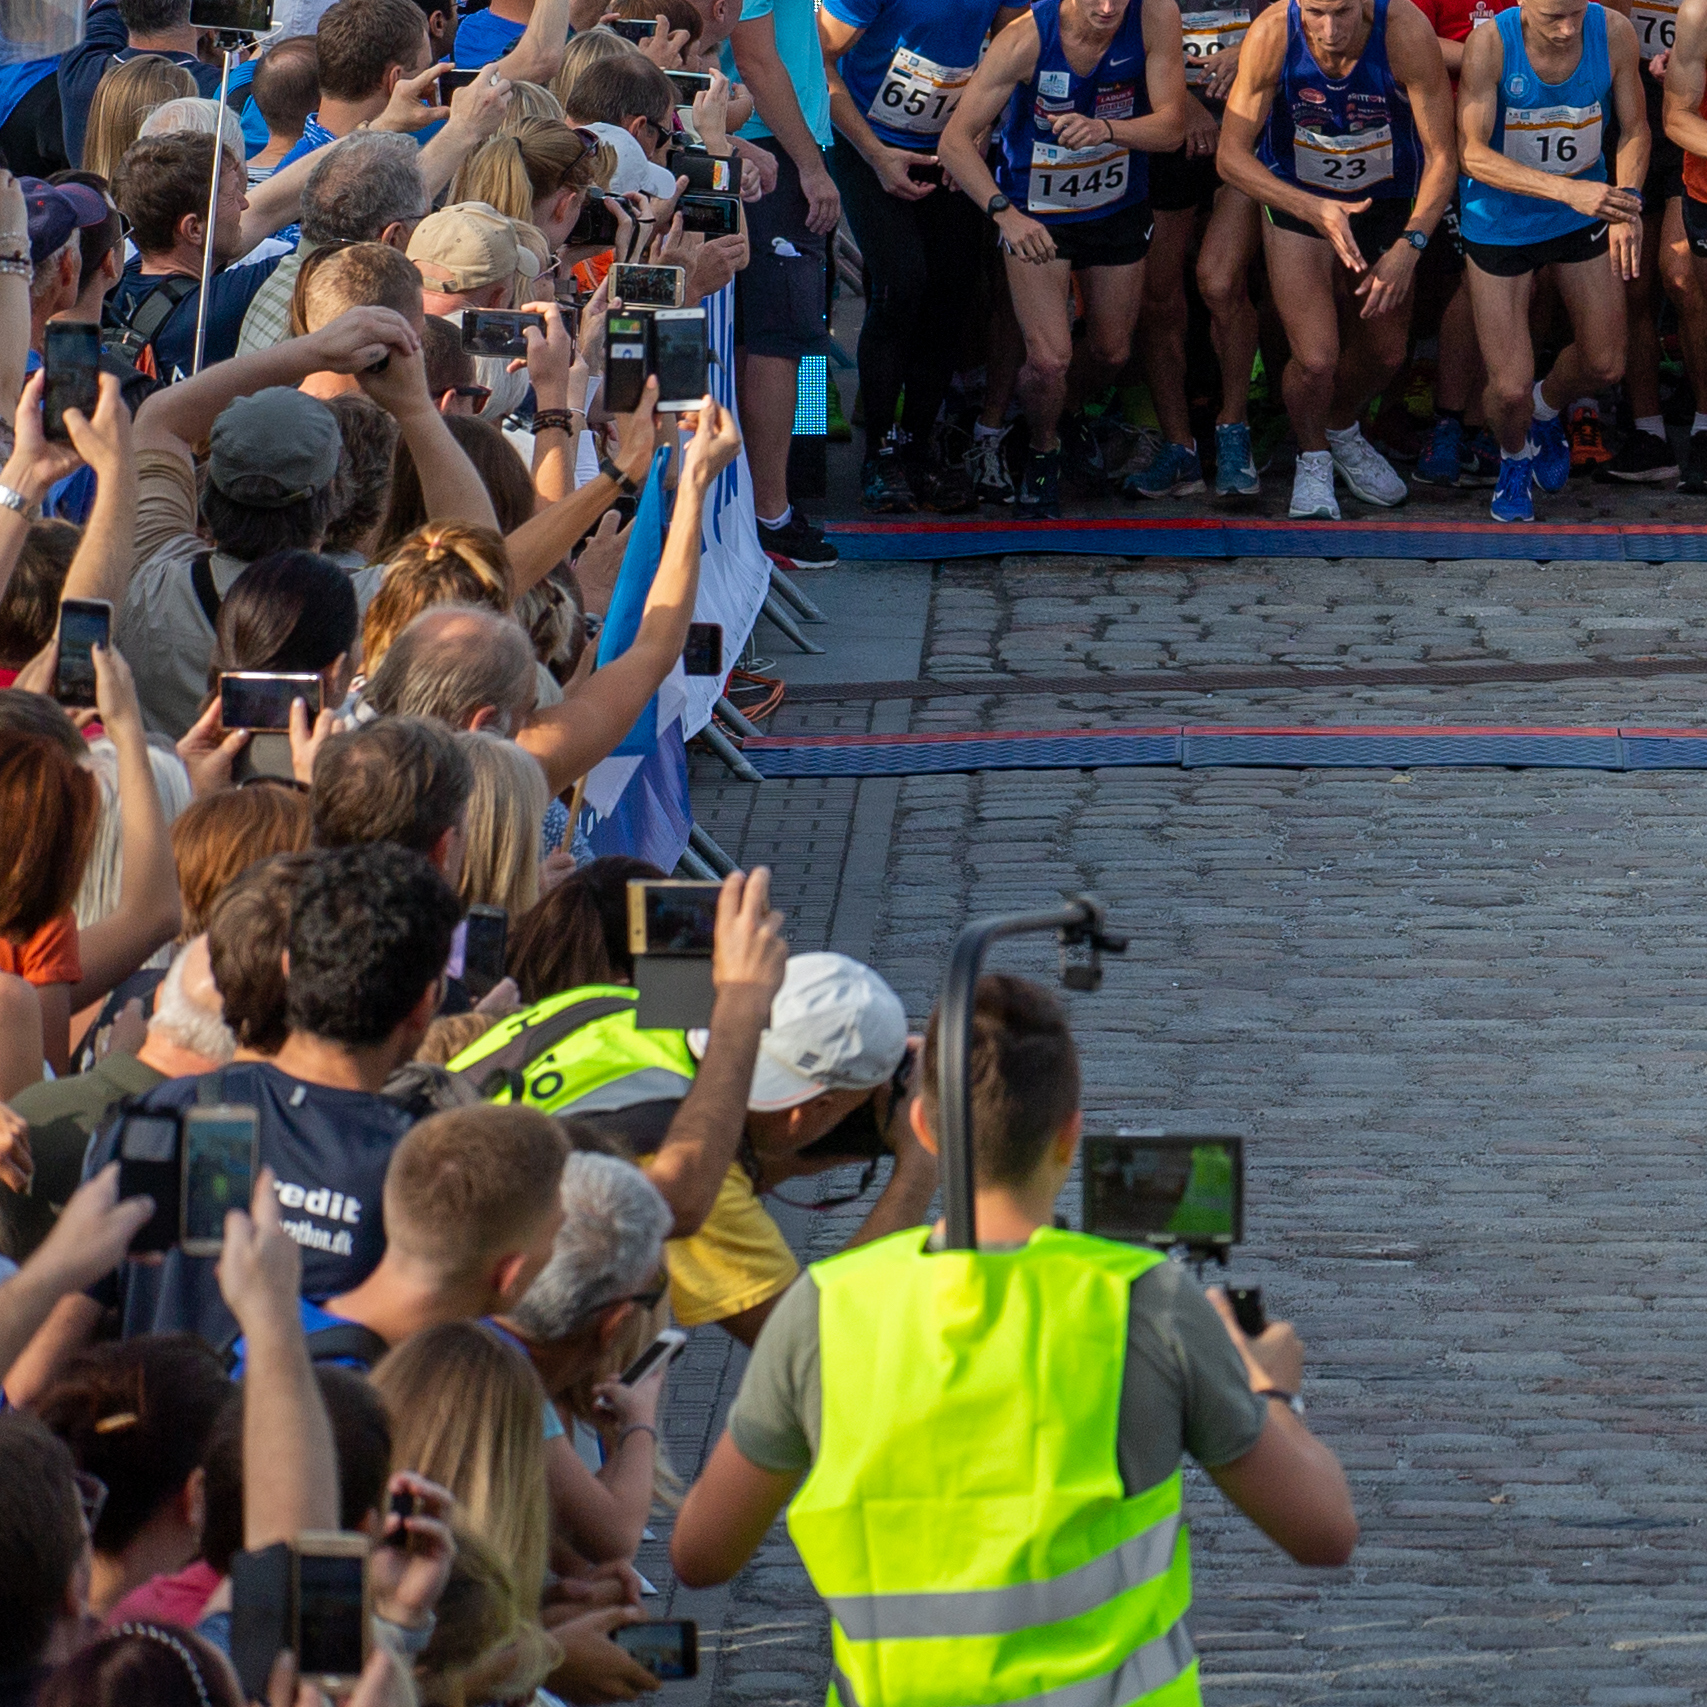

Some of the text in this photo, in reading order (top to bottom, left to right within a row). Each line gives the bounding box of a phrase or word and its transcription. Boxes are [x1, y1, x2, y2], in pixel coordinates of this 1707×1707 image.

[1536, 135, 1578, 163] 16
[1039, 161, 1125, 197] 1445
[1322, 157, 1368, 181] 23
[274, 1180, 363, 1225] edit
